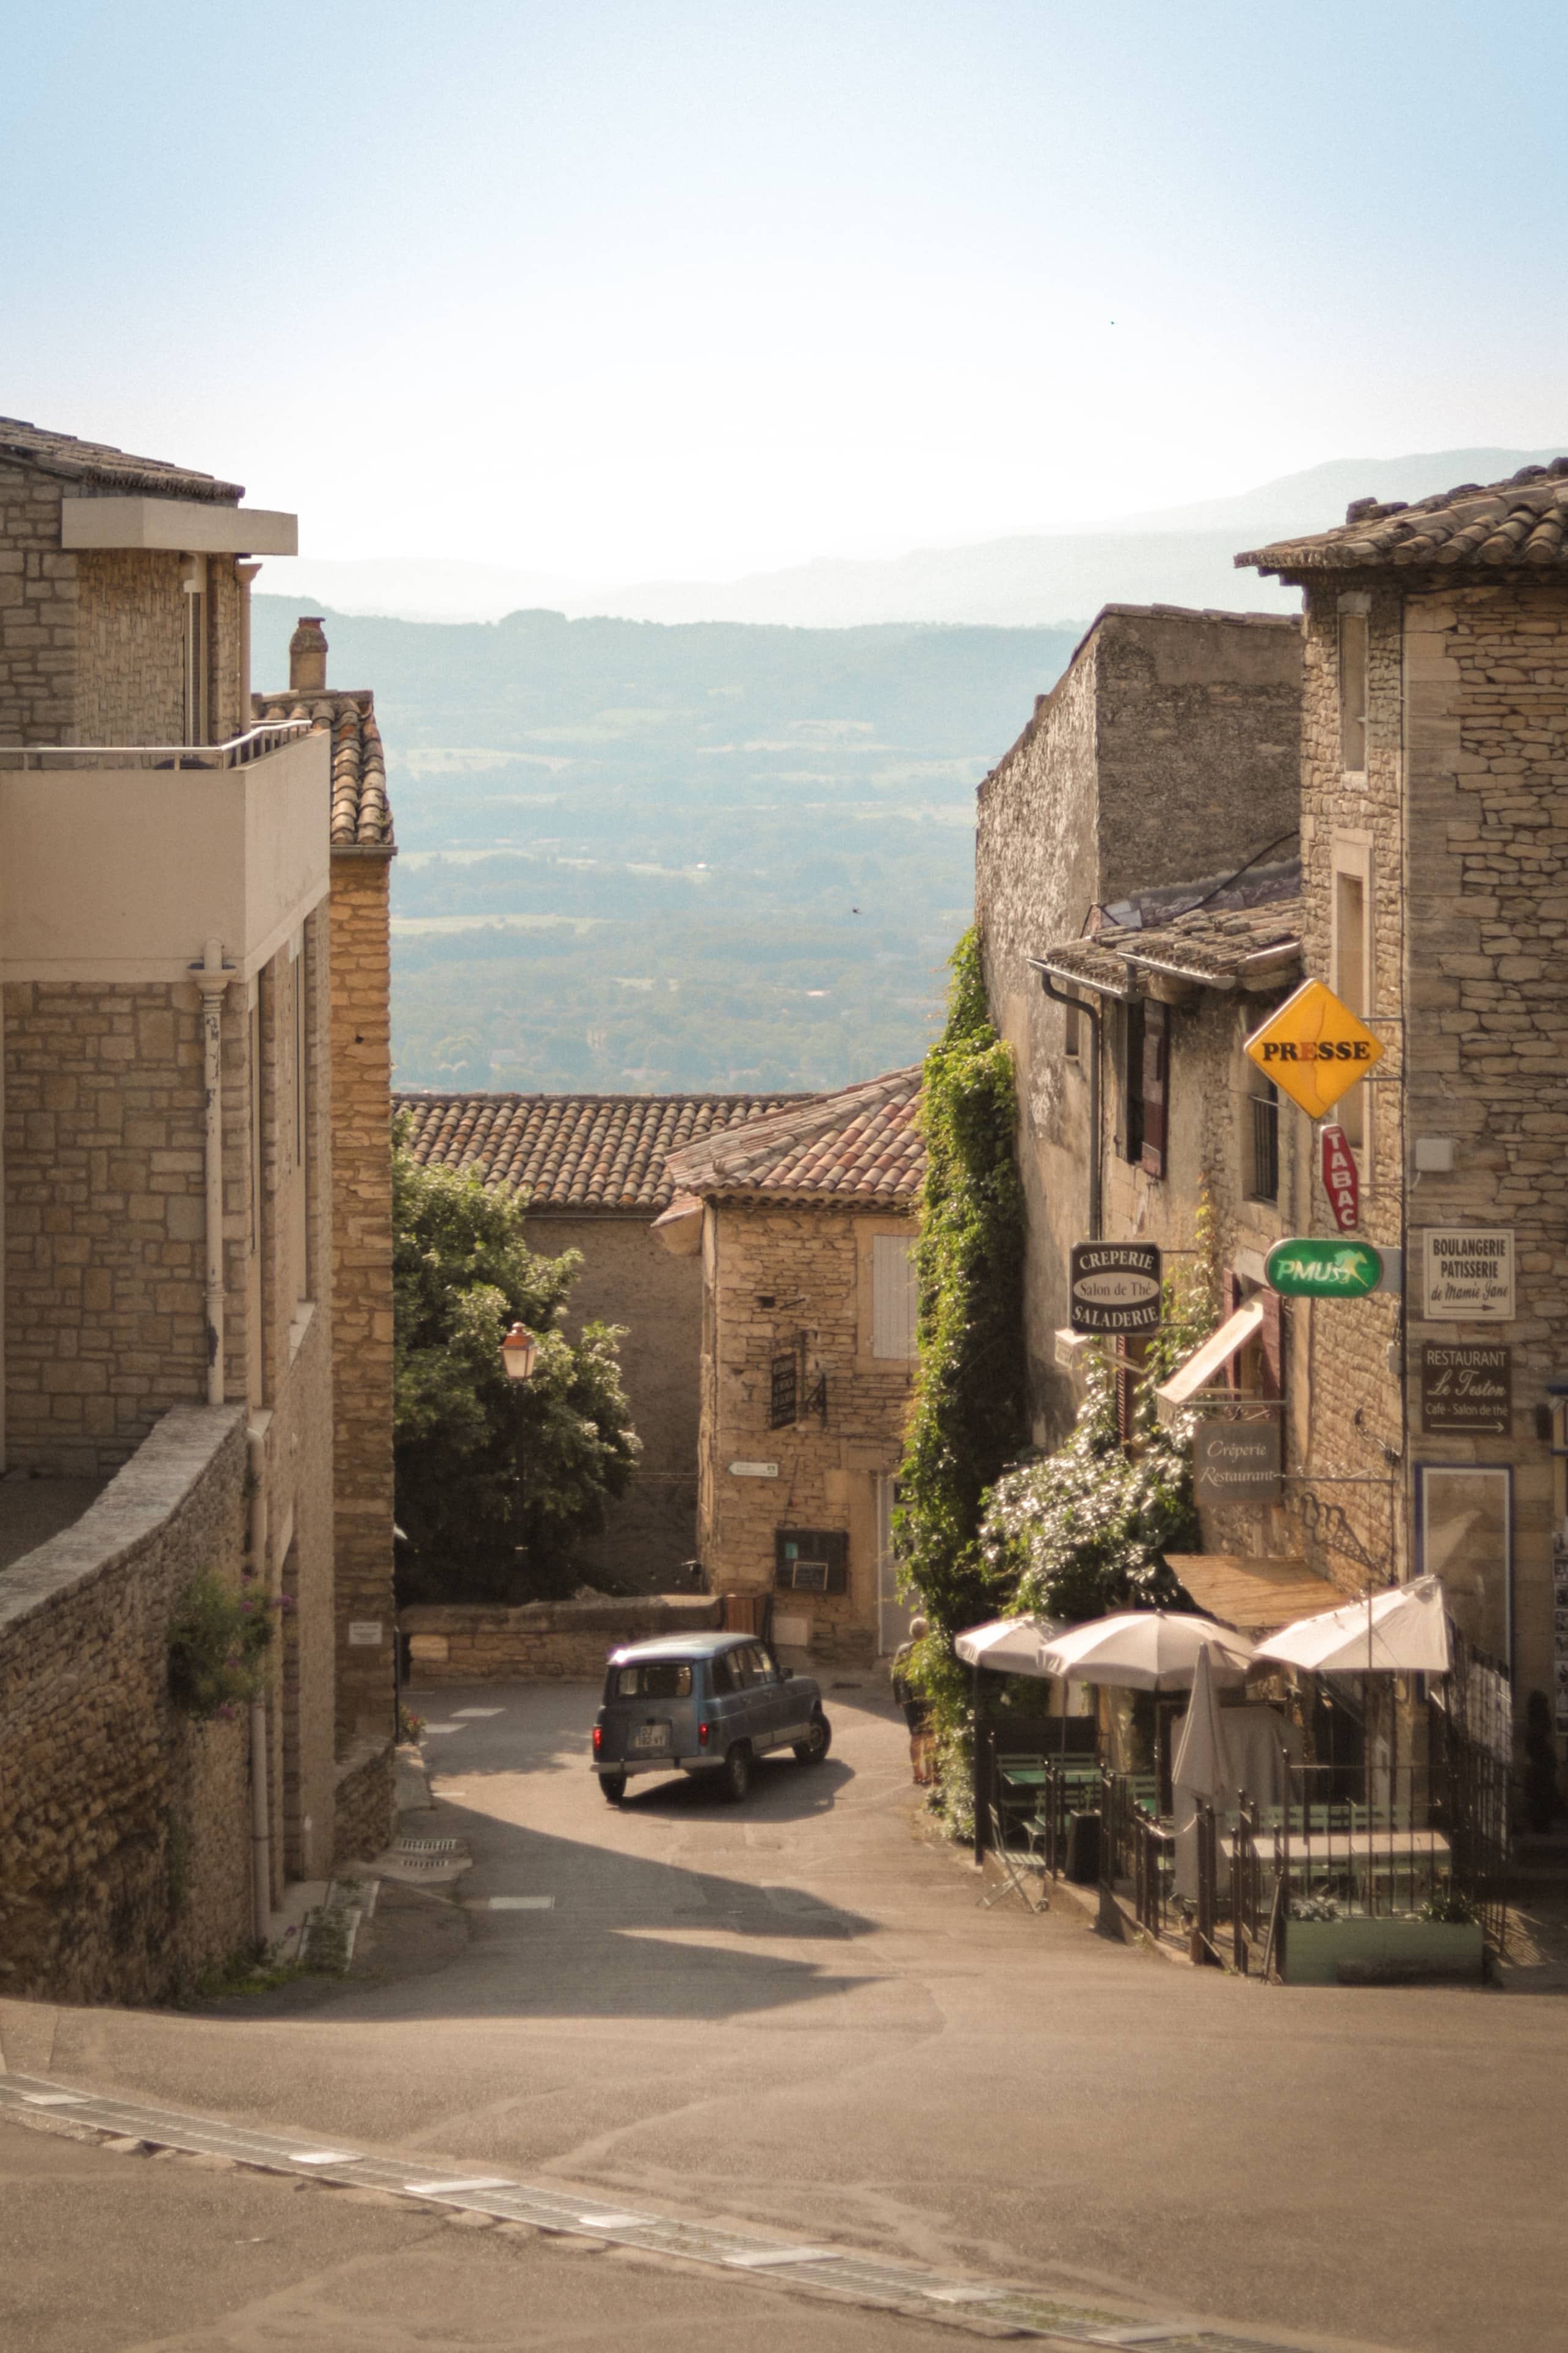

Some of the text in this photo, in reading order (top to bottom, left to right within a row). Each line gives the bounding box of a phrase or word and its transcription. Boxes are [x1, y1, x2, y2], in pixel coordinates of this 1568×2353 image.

[1262, 1041, 1370, 1061] PRESSE
[1327, 1133, 1356, 1226] TABAC
[1433, 1238, 1505, 1256] BOULANGERIE
[1079, 1251, 1153, 1270] CREPERIE
[1441, 1260, 1498, 1278] PATISSERIE
[1277, 1260, 1333, 1281] PMU
[1080, 1282, 1151, 1296] Salon de Thé
[1431, 1285, 1442, 1301] de
[1445, 1282, 1480, 1300] Mamie
[1072, 1306, 1158, 1327] SALADERIE
[1427, 1350, 1506, 1366] RESTAURANT
[1426, 1369, 1452, 1395] Le
[1426, 1403, 1445, 1414] Café
[1453, 1403, 1478, 1415] Salon
[1480, 1404, 1492, 1416] de
[1200, 1466, 1275, 1487] Restaurant
